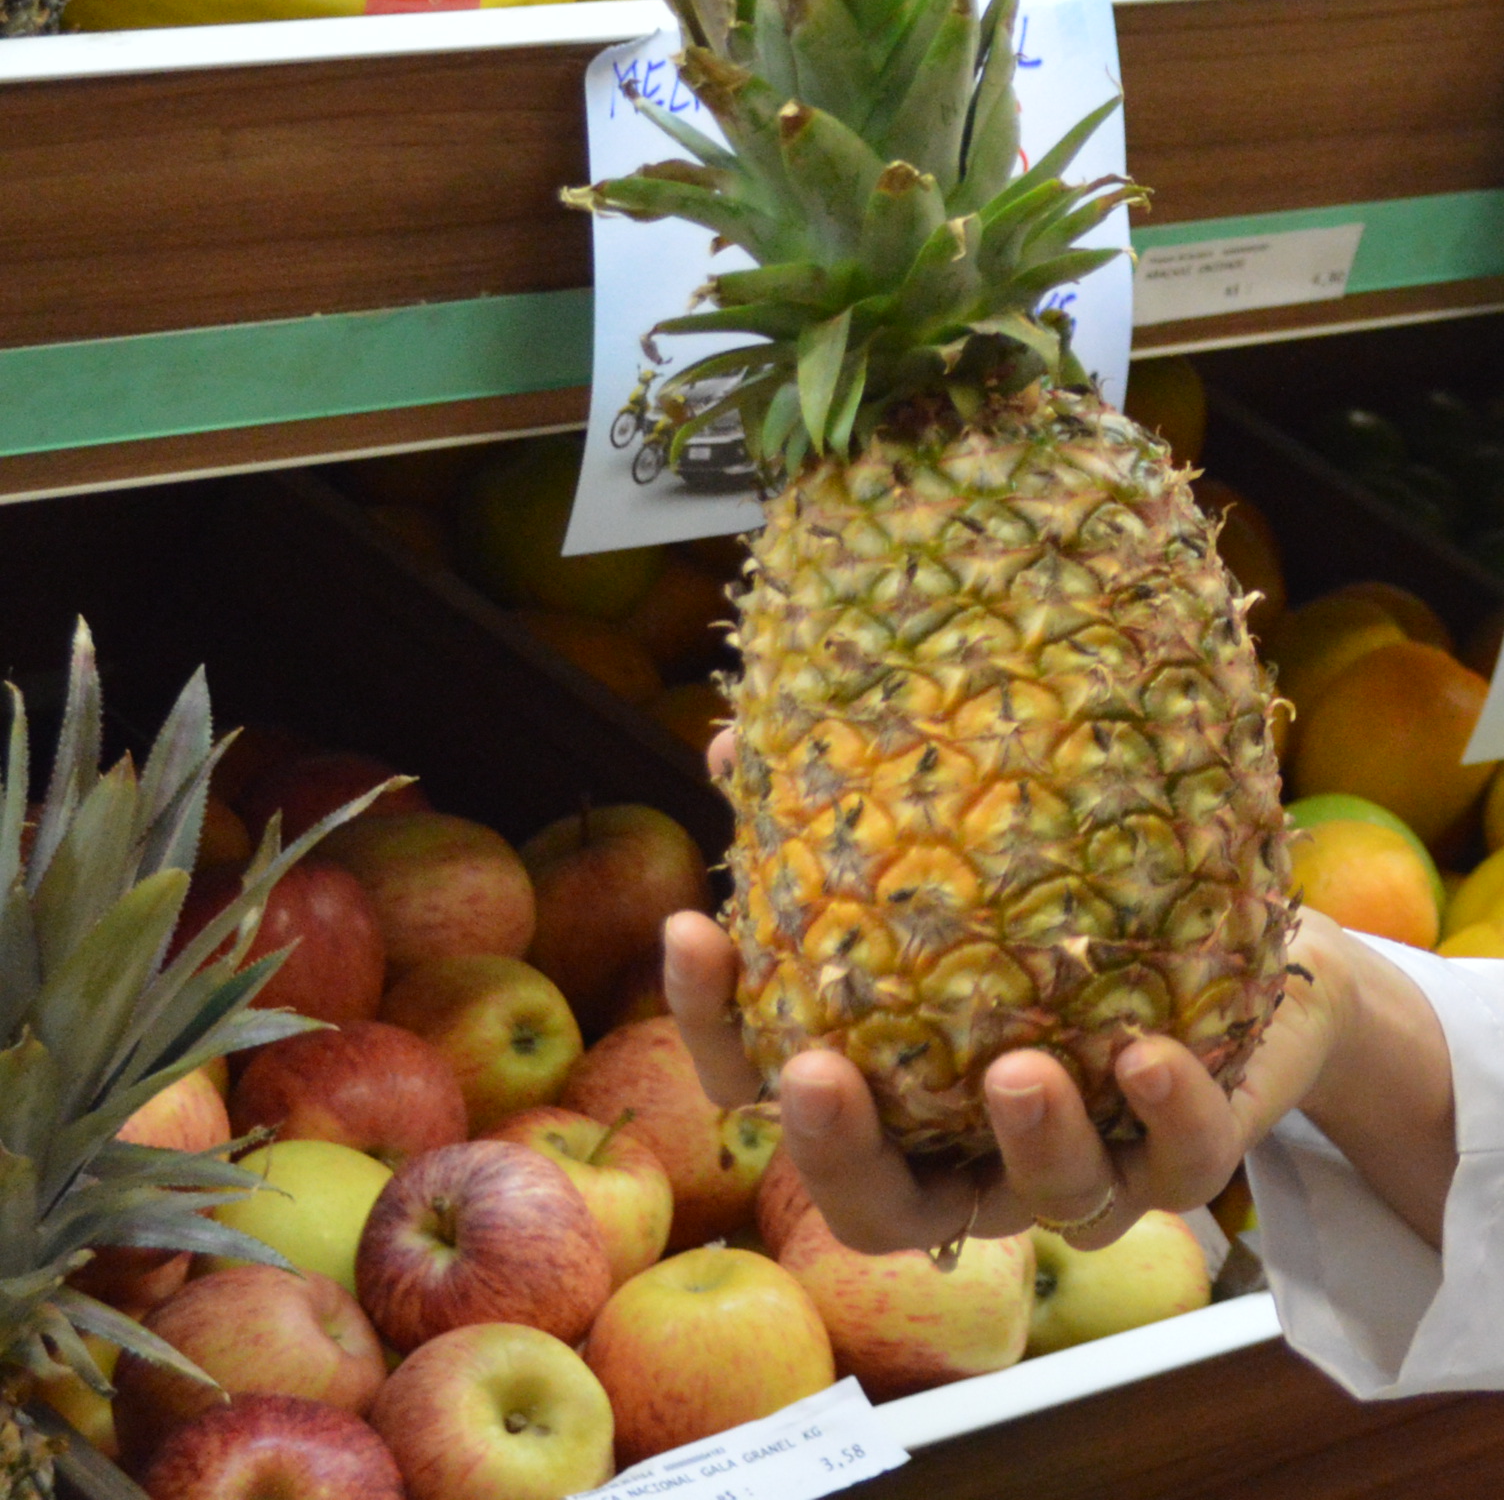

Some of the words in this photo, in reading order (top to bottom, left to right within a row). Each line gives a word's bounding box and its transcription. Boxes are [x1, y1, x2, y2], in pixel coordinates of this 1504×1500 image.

[610, 59, 700, 119] MEL
[627, 1473, 695, 1497] NACIONAL
[700, 1458, 737, 1478] GALA
[742, 1437, 796, 1463] GRANEL
[802, 1425, 824, 1441] KG
[820, 1443, 867, 1472] 3,58
